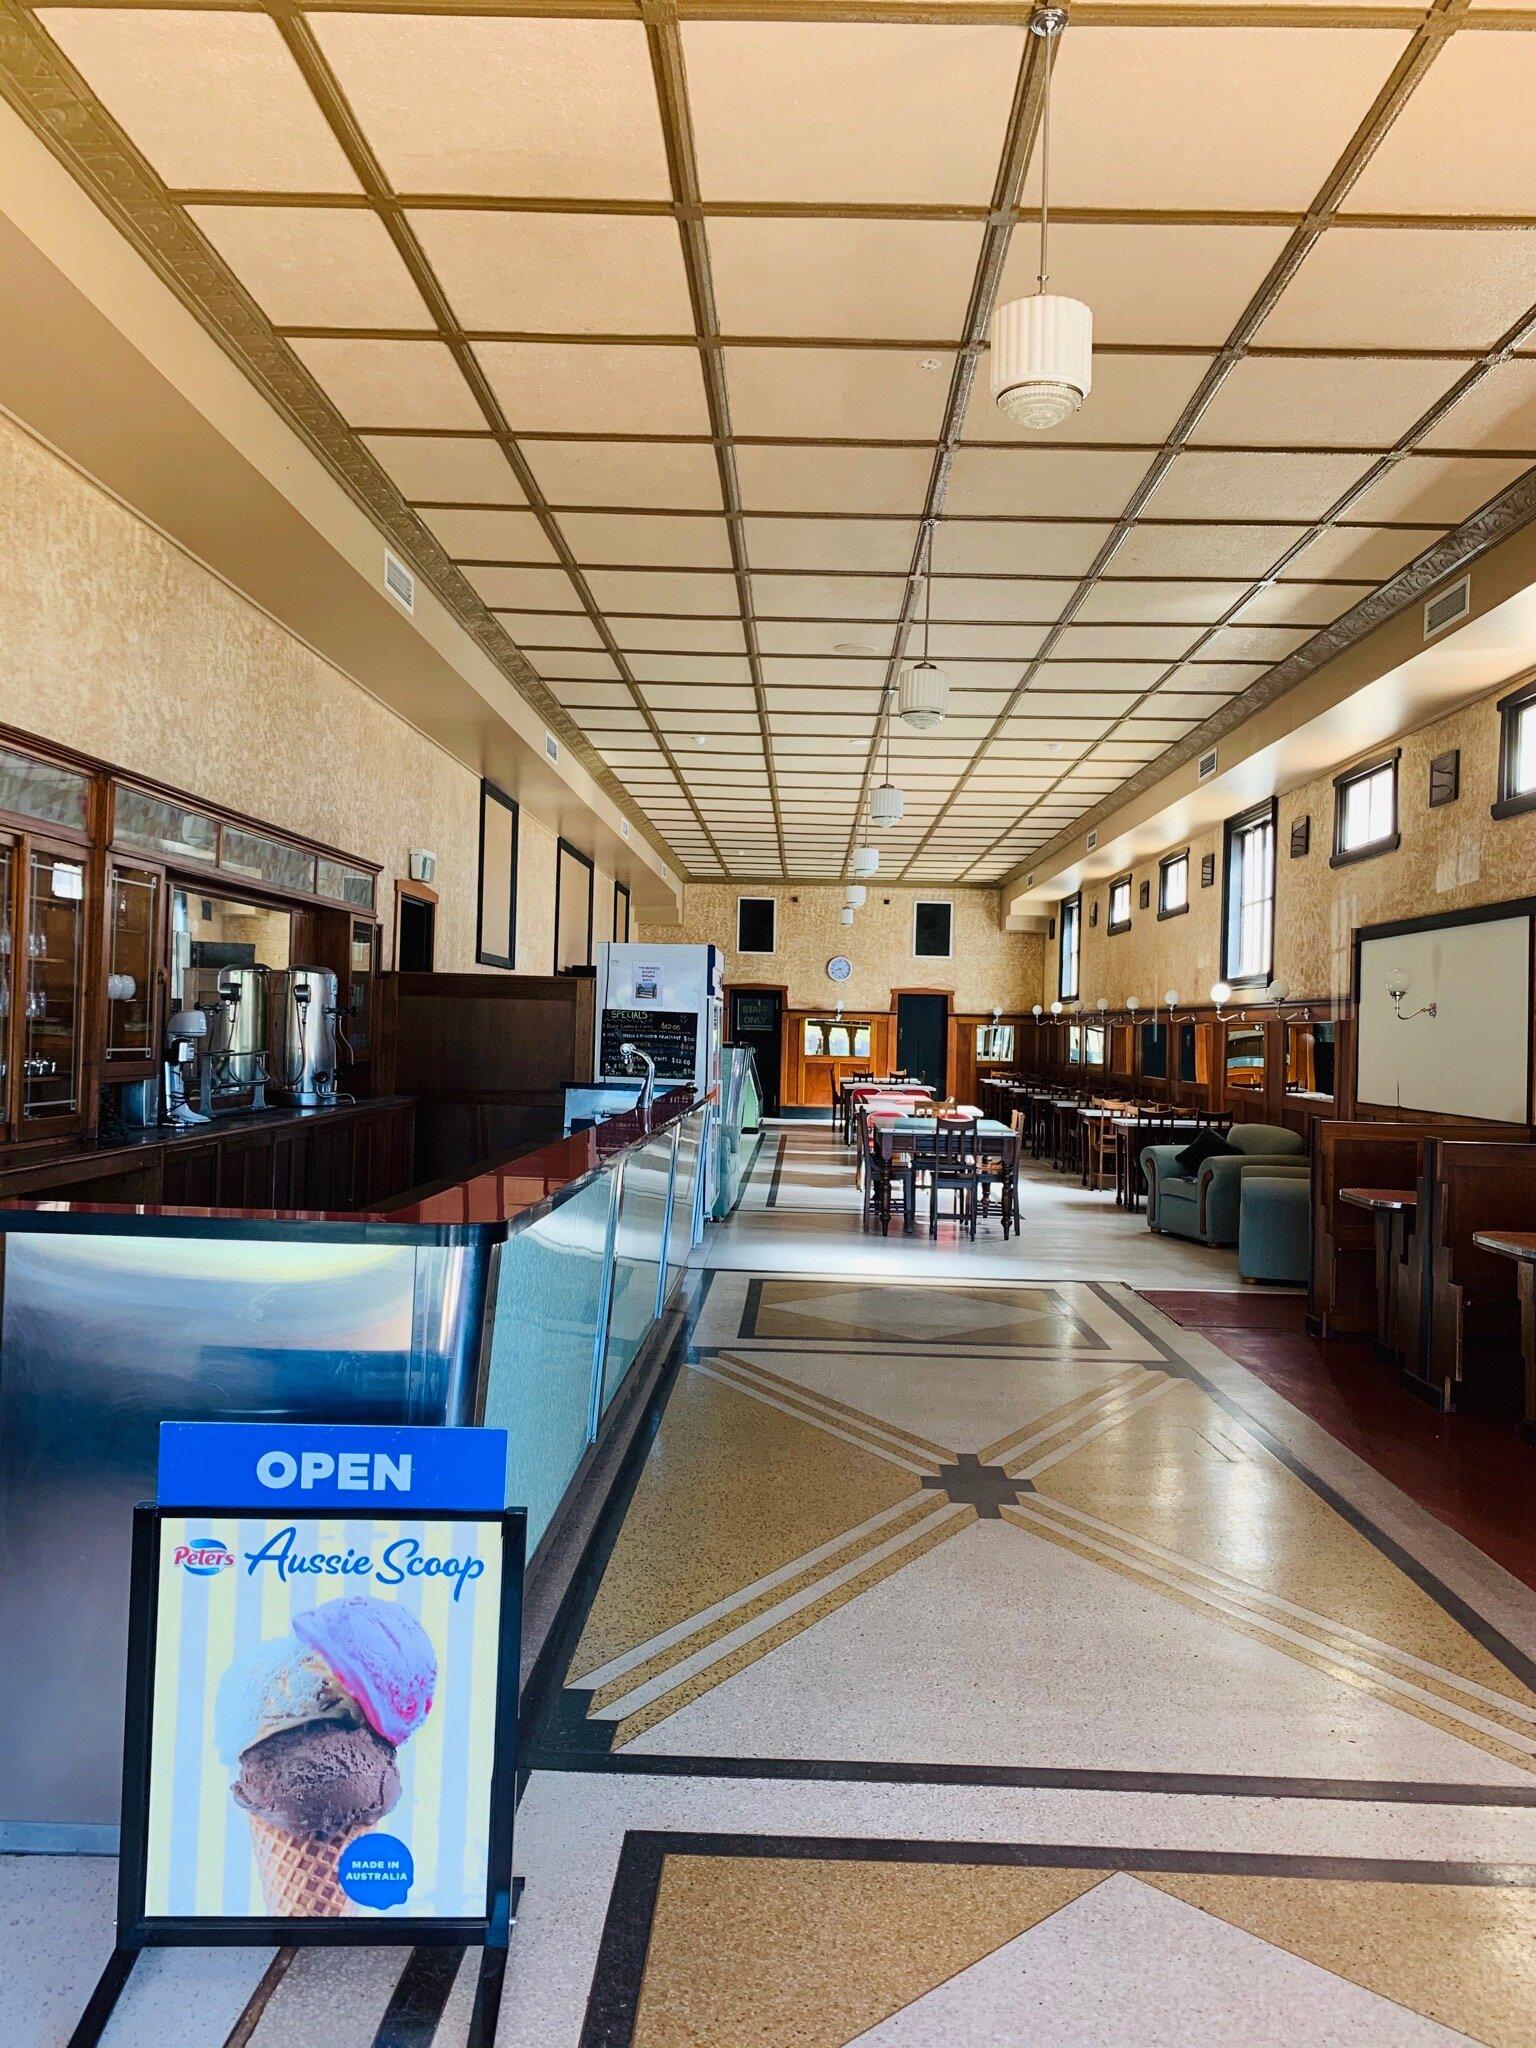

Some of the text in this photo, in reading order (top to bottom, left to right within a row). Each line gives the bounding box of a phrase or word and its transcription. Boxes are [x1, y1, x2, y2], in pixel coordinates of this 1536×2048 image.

[742, 1005, 768, 1013] STAFF
[611, 1010, 648, 1020] SPECIALS
[743, 1016, 766, 1024] ONLY
[256, 1450, 412, 1491] OPEN
[173, 1526, 485, 1603] Peters Aussie Scoop
[351, 1860, 400, 1869] MADE IN
[345, 1872, 408, 1881] AUSTRALIA
